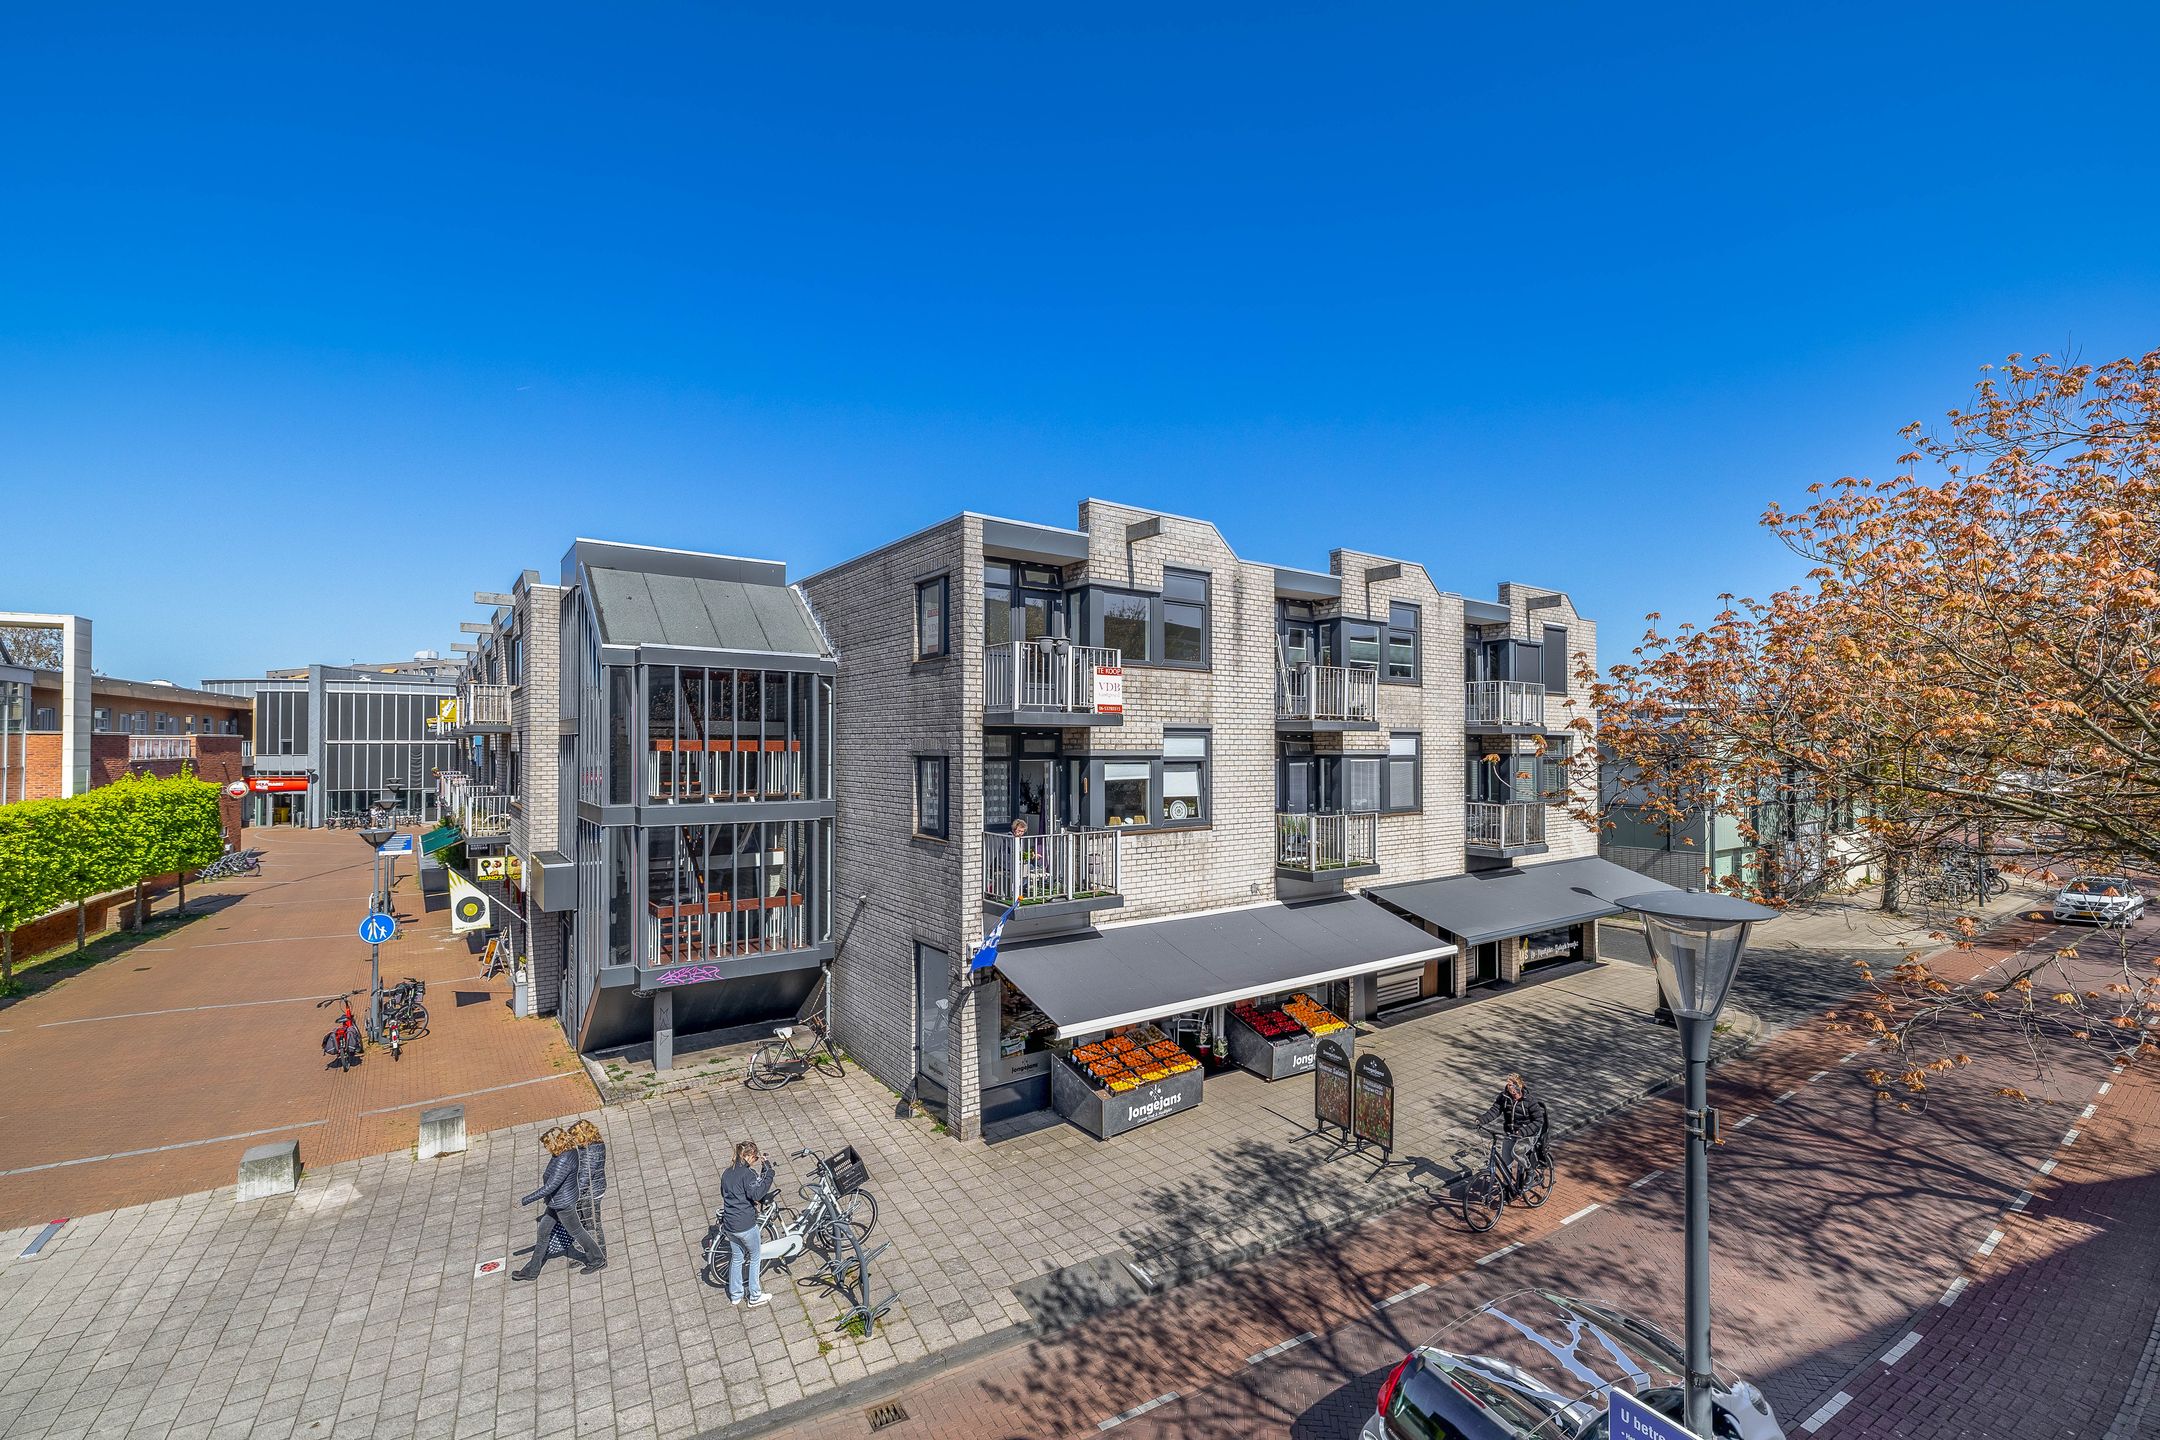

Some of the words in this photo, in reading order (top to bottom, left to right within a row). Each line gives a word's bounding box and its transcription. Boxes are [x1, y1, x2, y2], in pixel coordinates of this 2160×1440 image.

[1098, 681, 1121, 692] VDB
[1127, 1092, 1182, 1122] Jongejans
[1620, 1408, 1630, 1424] U
